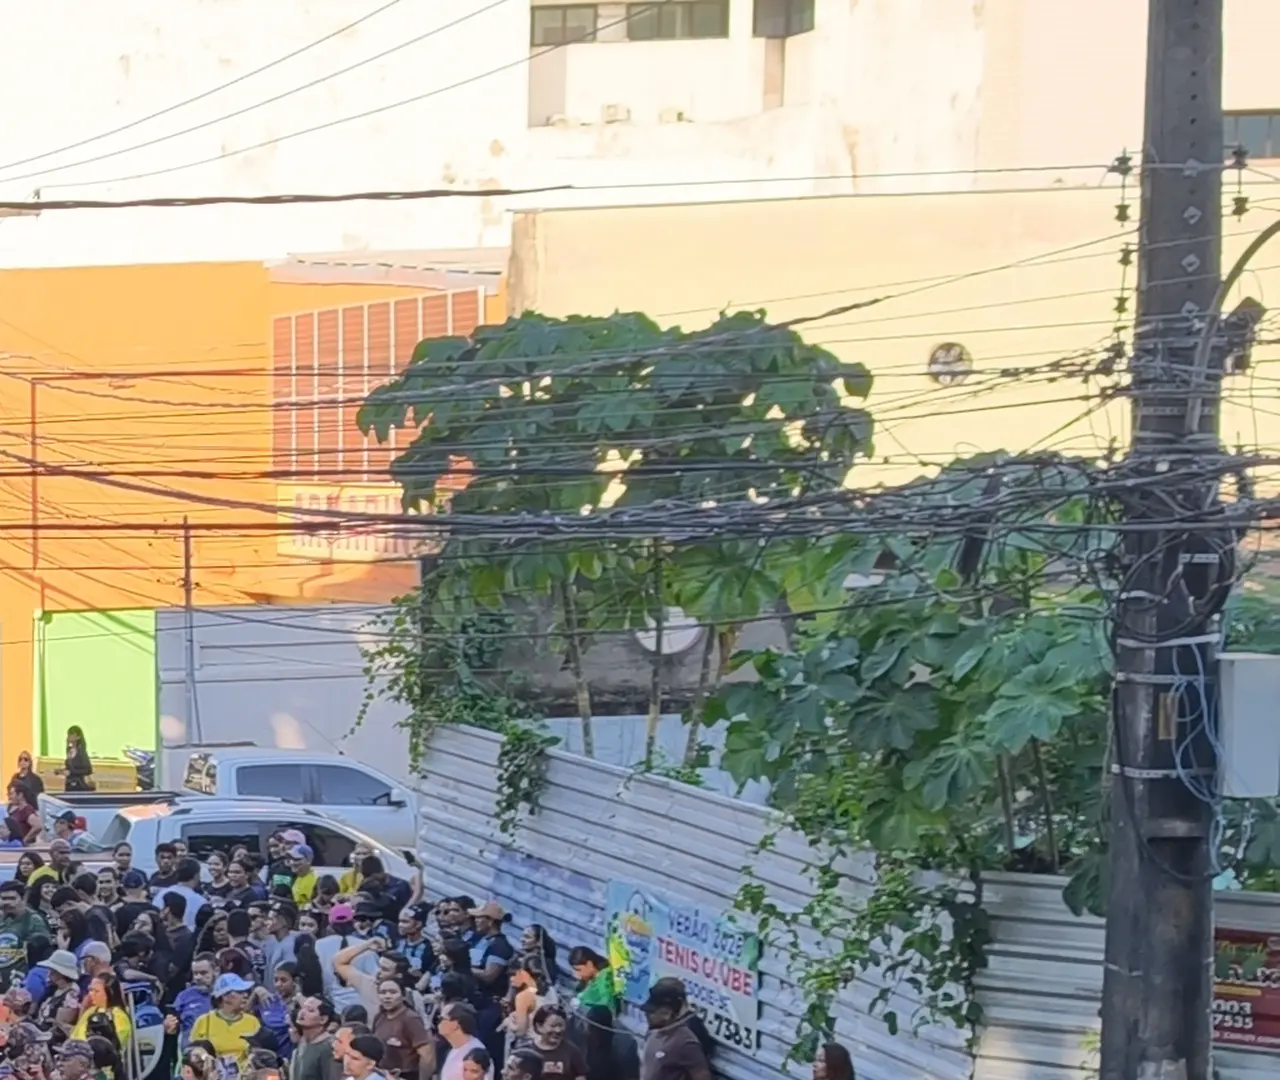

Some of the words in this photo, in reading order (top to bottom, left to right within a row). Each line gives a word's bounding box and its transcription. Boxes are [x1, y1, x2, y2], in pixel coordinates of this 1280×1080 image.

[668, 909, 709, 944] VERÃO
[656, 934, 700, 974] TÊNIS
[702, 957, 753, 997] CLUBE
